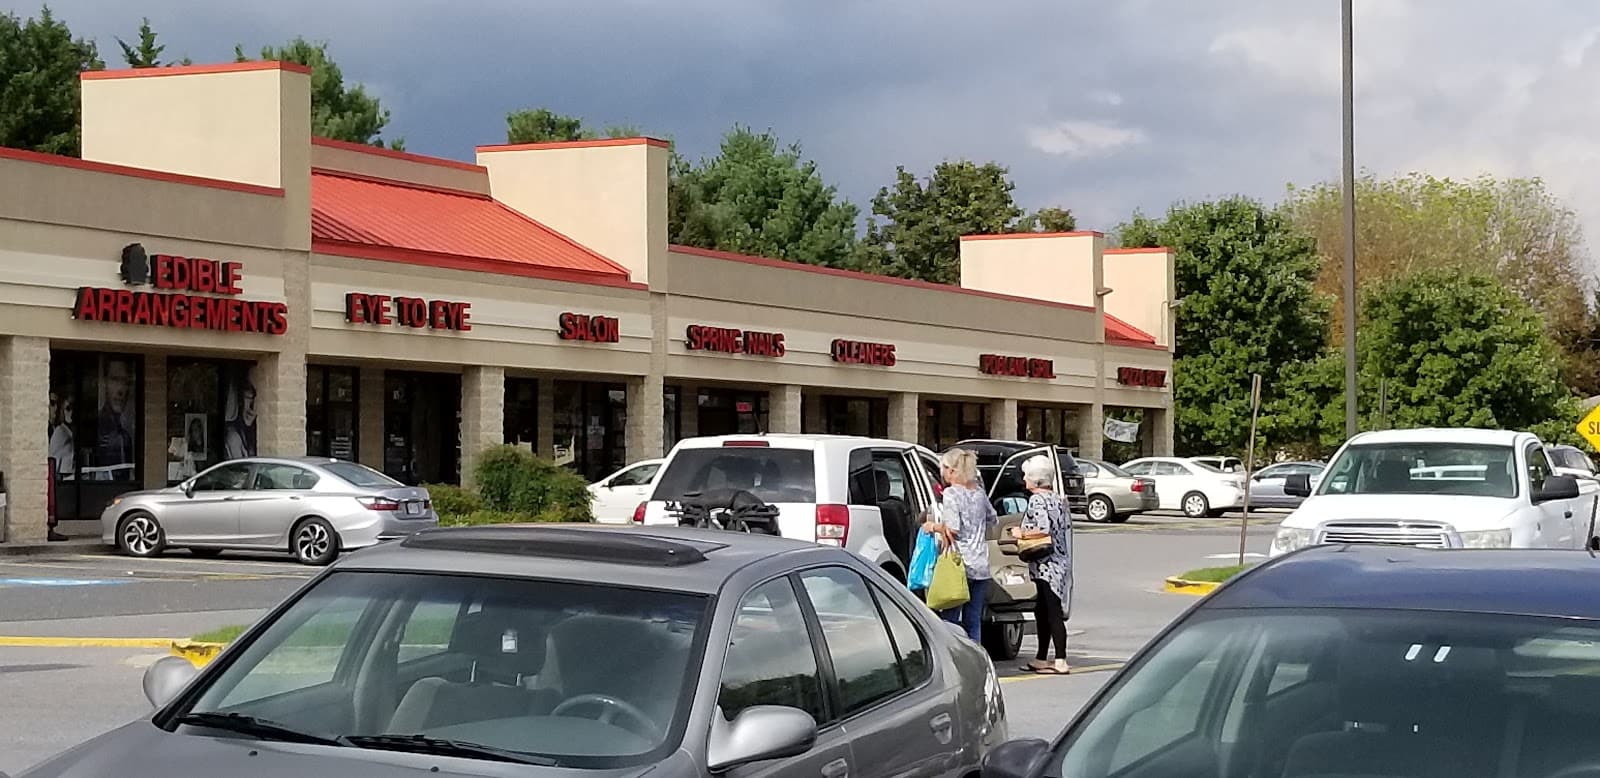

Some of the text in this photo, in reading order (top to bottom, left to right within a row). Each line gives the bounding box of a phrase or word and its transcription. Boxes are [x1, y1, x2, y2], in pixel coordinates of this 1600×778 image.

[150, 254, 243, 295] EDIBLE
[73, 286, 288, 335] ARRANGEMENTS
[345, 292, 472, 331] EYE TO EYE
[558, 312, 620, 343] SALON
[685, 324, 785, 357] SPRING NAILS
[830, 338, 897, 367] CLEANERS
